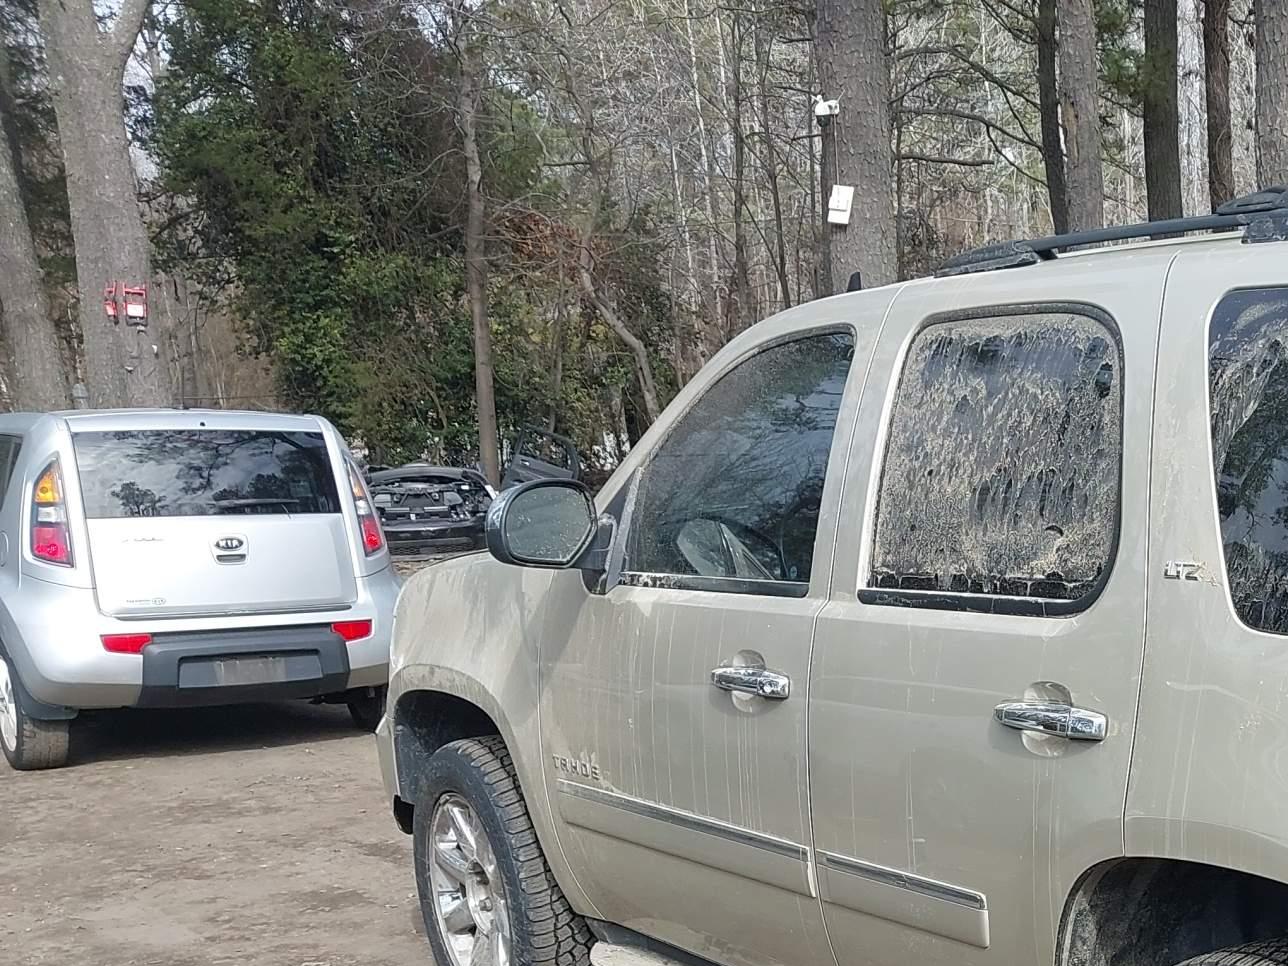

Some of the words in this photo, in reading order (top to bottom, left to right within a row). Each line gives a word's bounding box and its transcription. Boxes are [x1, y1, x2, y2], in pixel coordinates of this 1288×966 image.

[217, 538, 242, 550] KIA
[1163, 560, 1200, 581] LTZ
[552, 753, 601, 781] TAHOE
